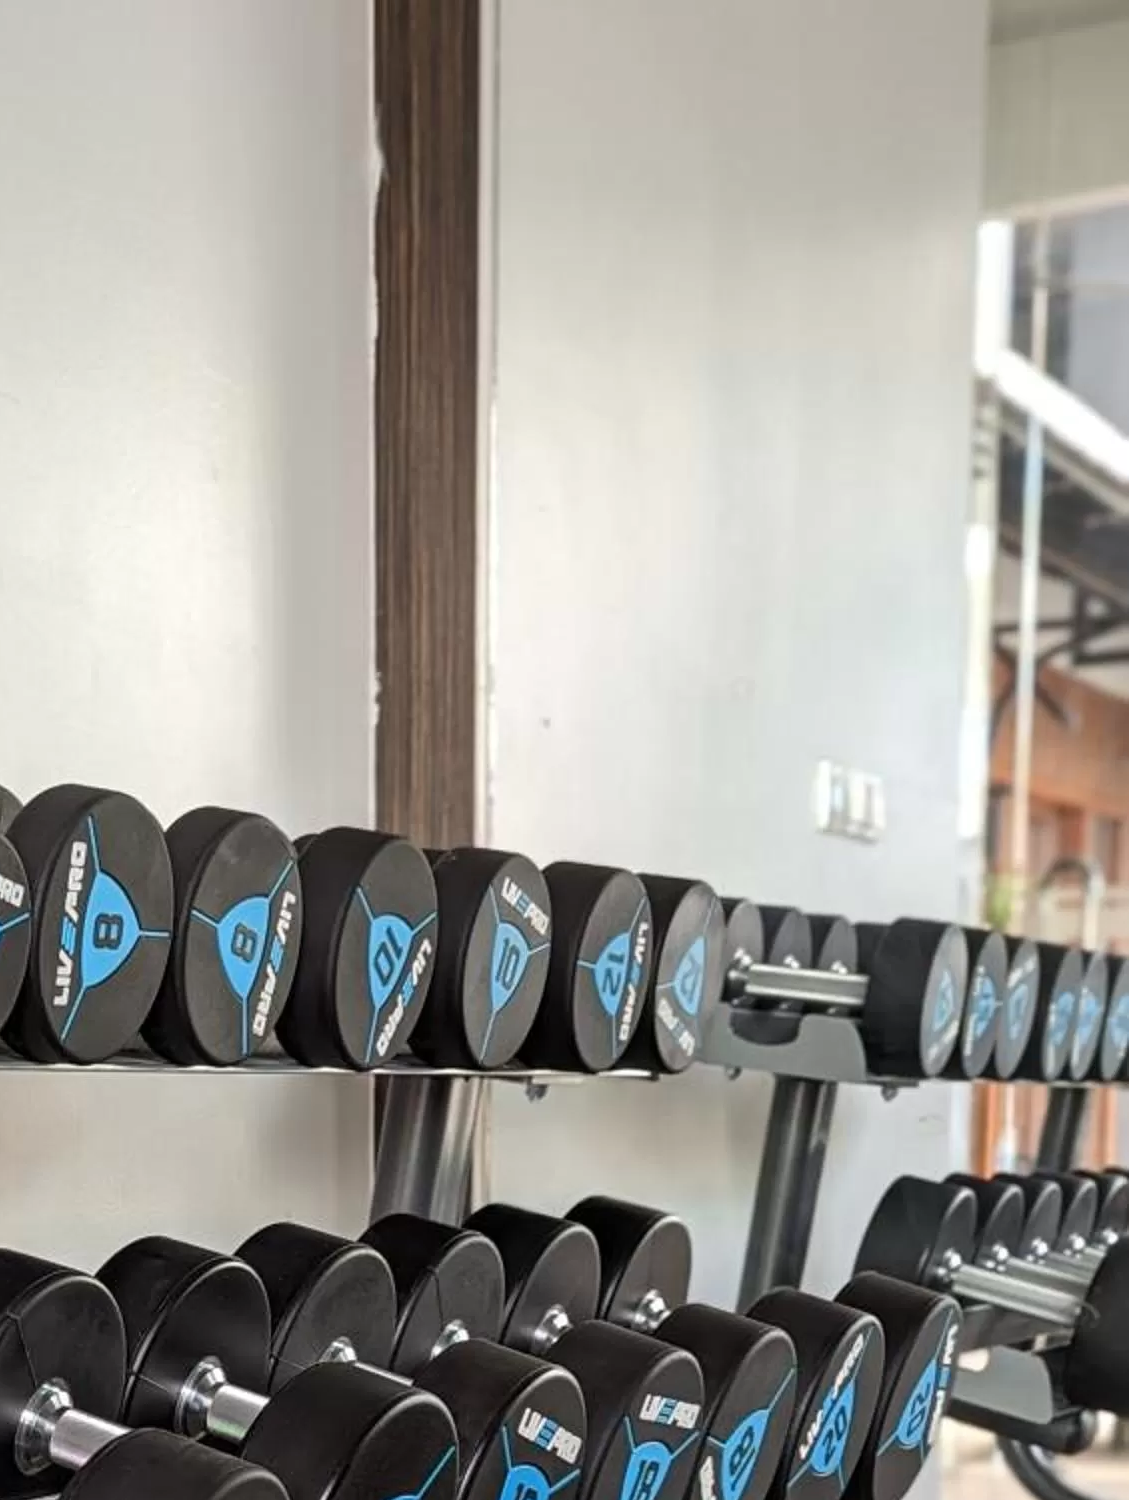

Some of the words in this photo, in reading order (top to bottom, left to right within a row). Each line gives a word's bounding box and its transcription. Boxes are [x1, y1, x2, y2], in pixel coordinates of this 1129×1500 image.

[53, 841, 87, 1007] LIVEPRO
[93, 914, 123, 950] 8
[501, 877, 550, 936] LIVEPRO
[231, 922, 257, 963] 8
[253, 891, 296, 1036] LIVEPRO
[374, 926, 404, 987] 10
[495, 937, 519, 991] 10
[376, 938, 431, 1056] LIVEPRO
[518, 1408, 582, 1464] LIVEPRO
[639, 1394, 701, 1429] LIVEPRO
[823, 1405, 847, 1466] 20
[907, 1383, 930, 1437] 20
[730, 1426, 755, 1491] 18
